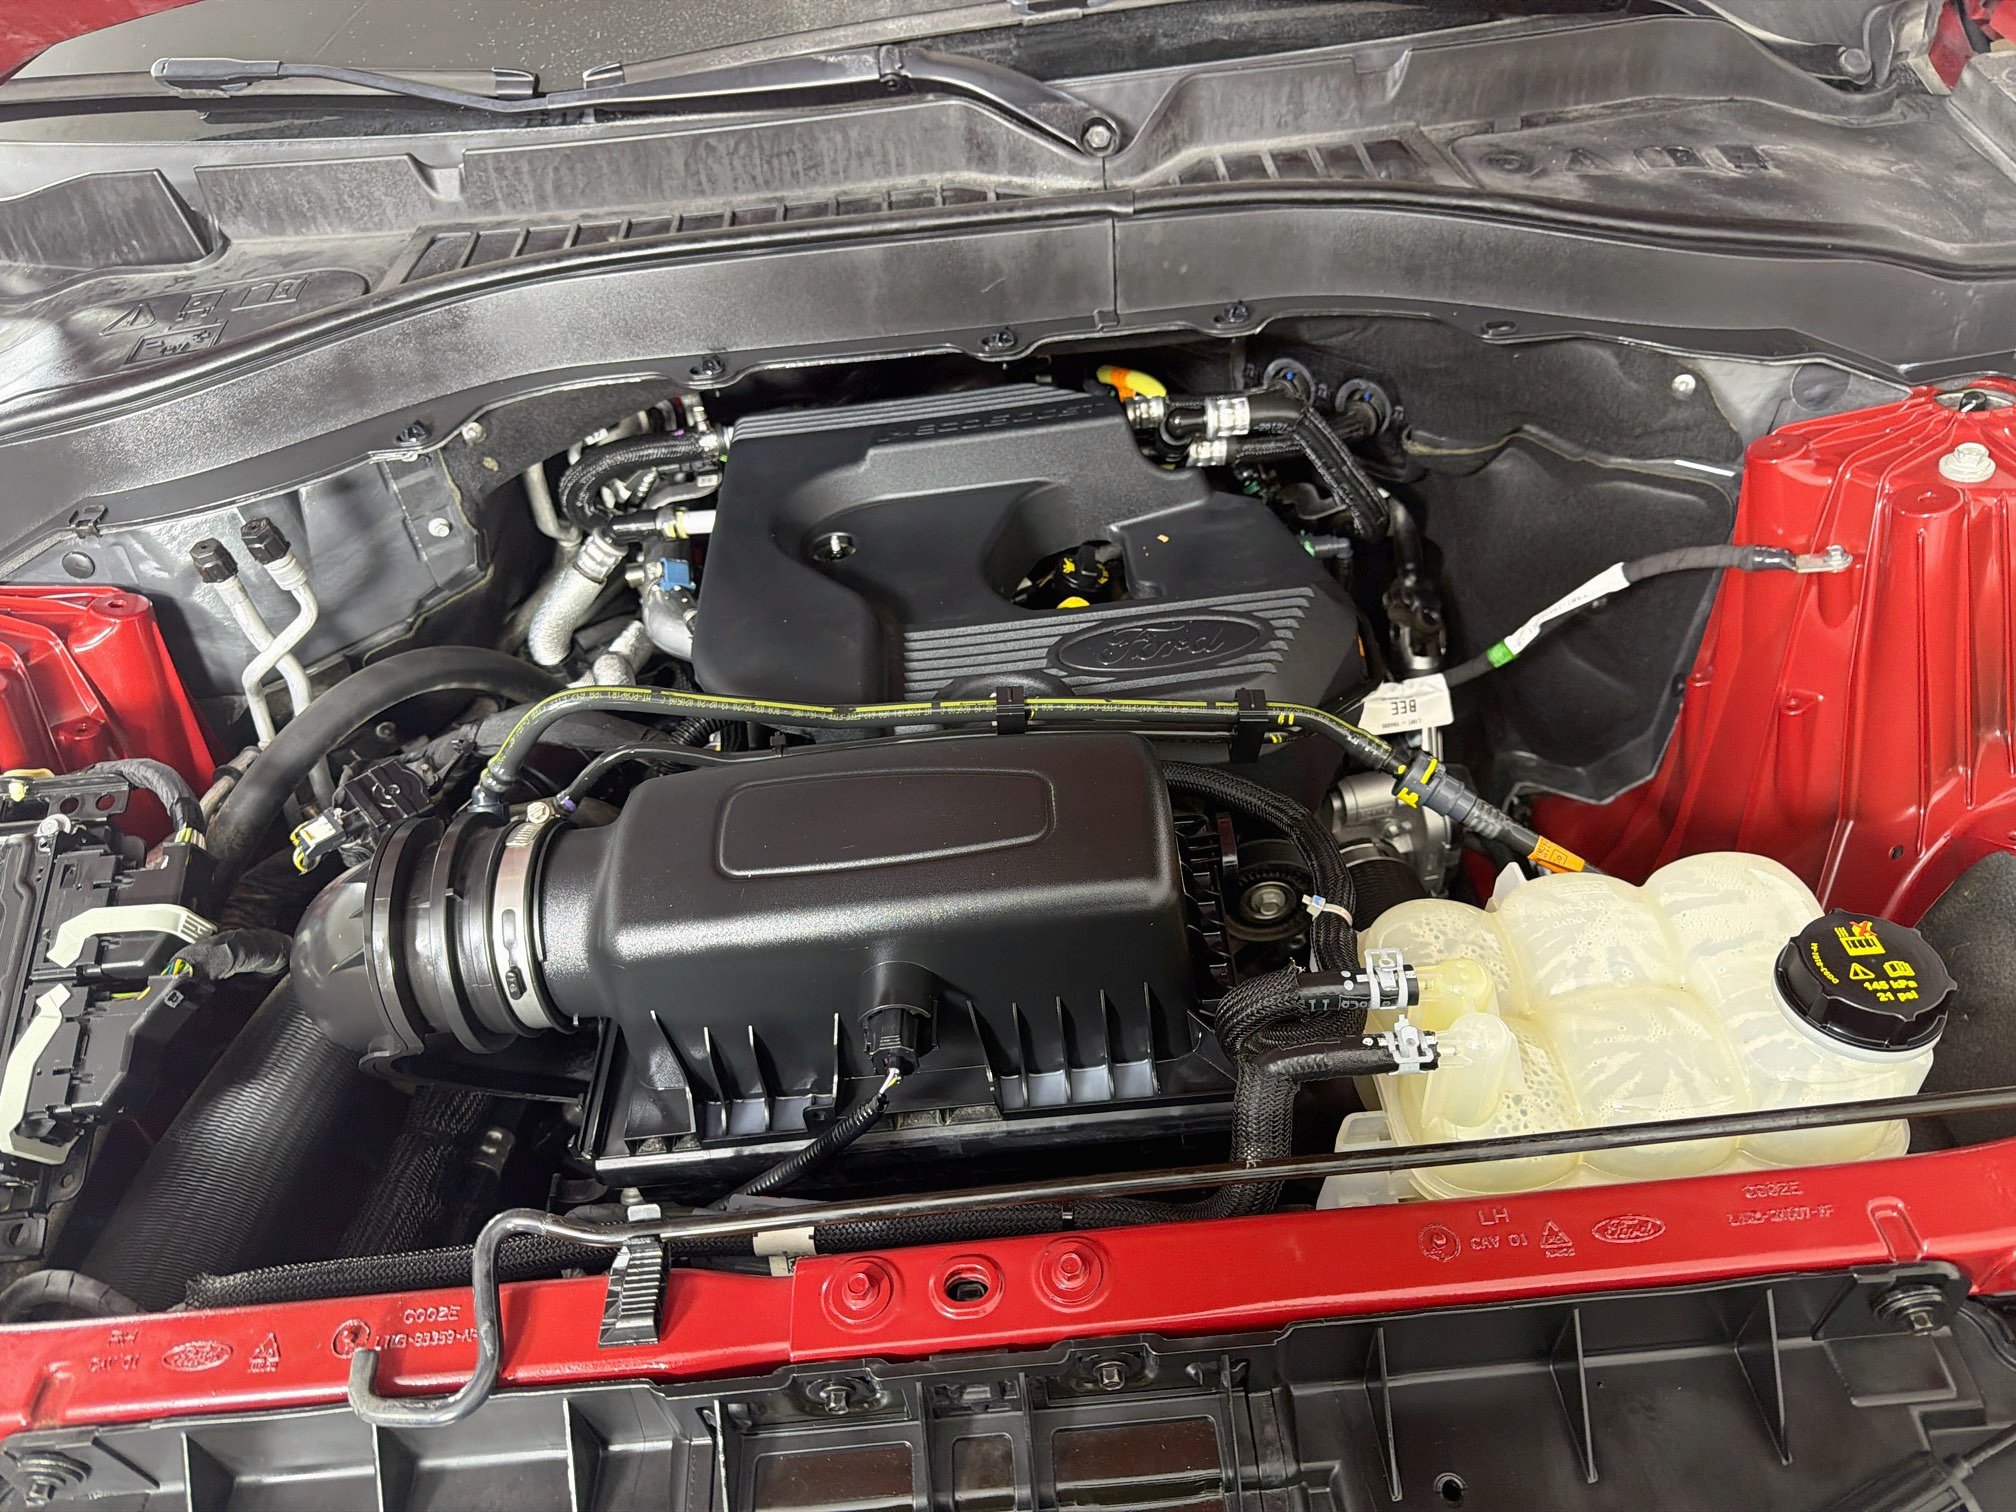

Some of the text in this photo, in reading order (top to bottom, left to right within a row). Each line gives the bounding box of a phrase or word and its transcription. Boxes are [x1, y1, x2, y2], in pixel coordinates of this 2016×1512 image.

[1863, 979, 1918, 991] 145 kPa
[1876, 990, 1919, 1002] 21 psi
[1478, 1207, 1510, 1226] LH
